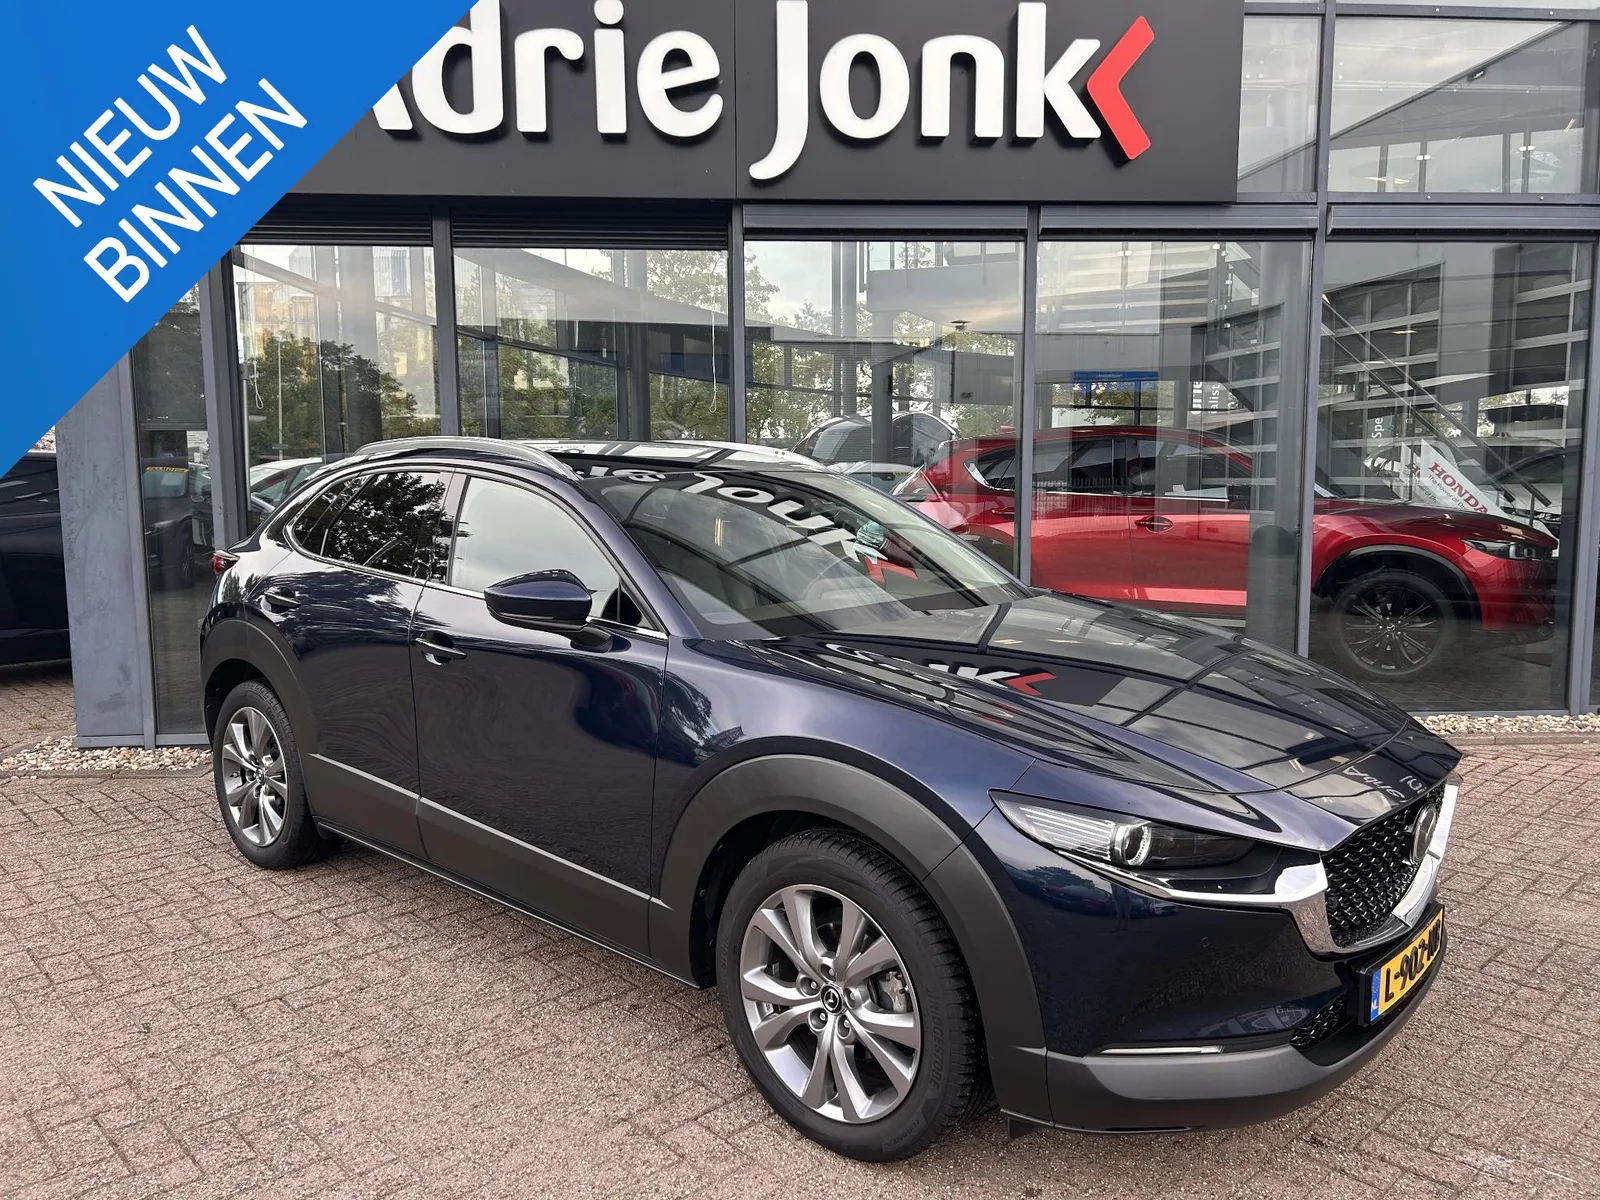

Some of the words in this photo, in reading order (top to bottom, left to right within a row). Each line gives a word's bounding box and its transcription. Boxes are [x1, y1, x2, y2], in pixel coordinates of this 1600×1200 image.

[373, 0, 723, 137] drie
[748, 0, 1101, 180] Jonk
[1429, 462, 1488, 514] HONDA
